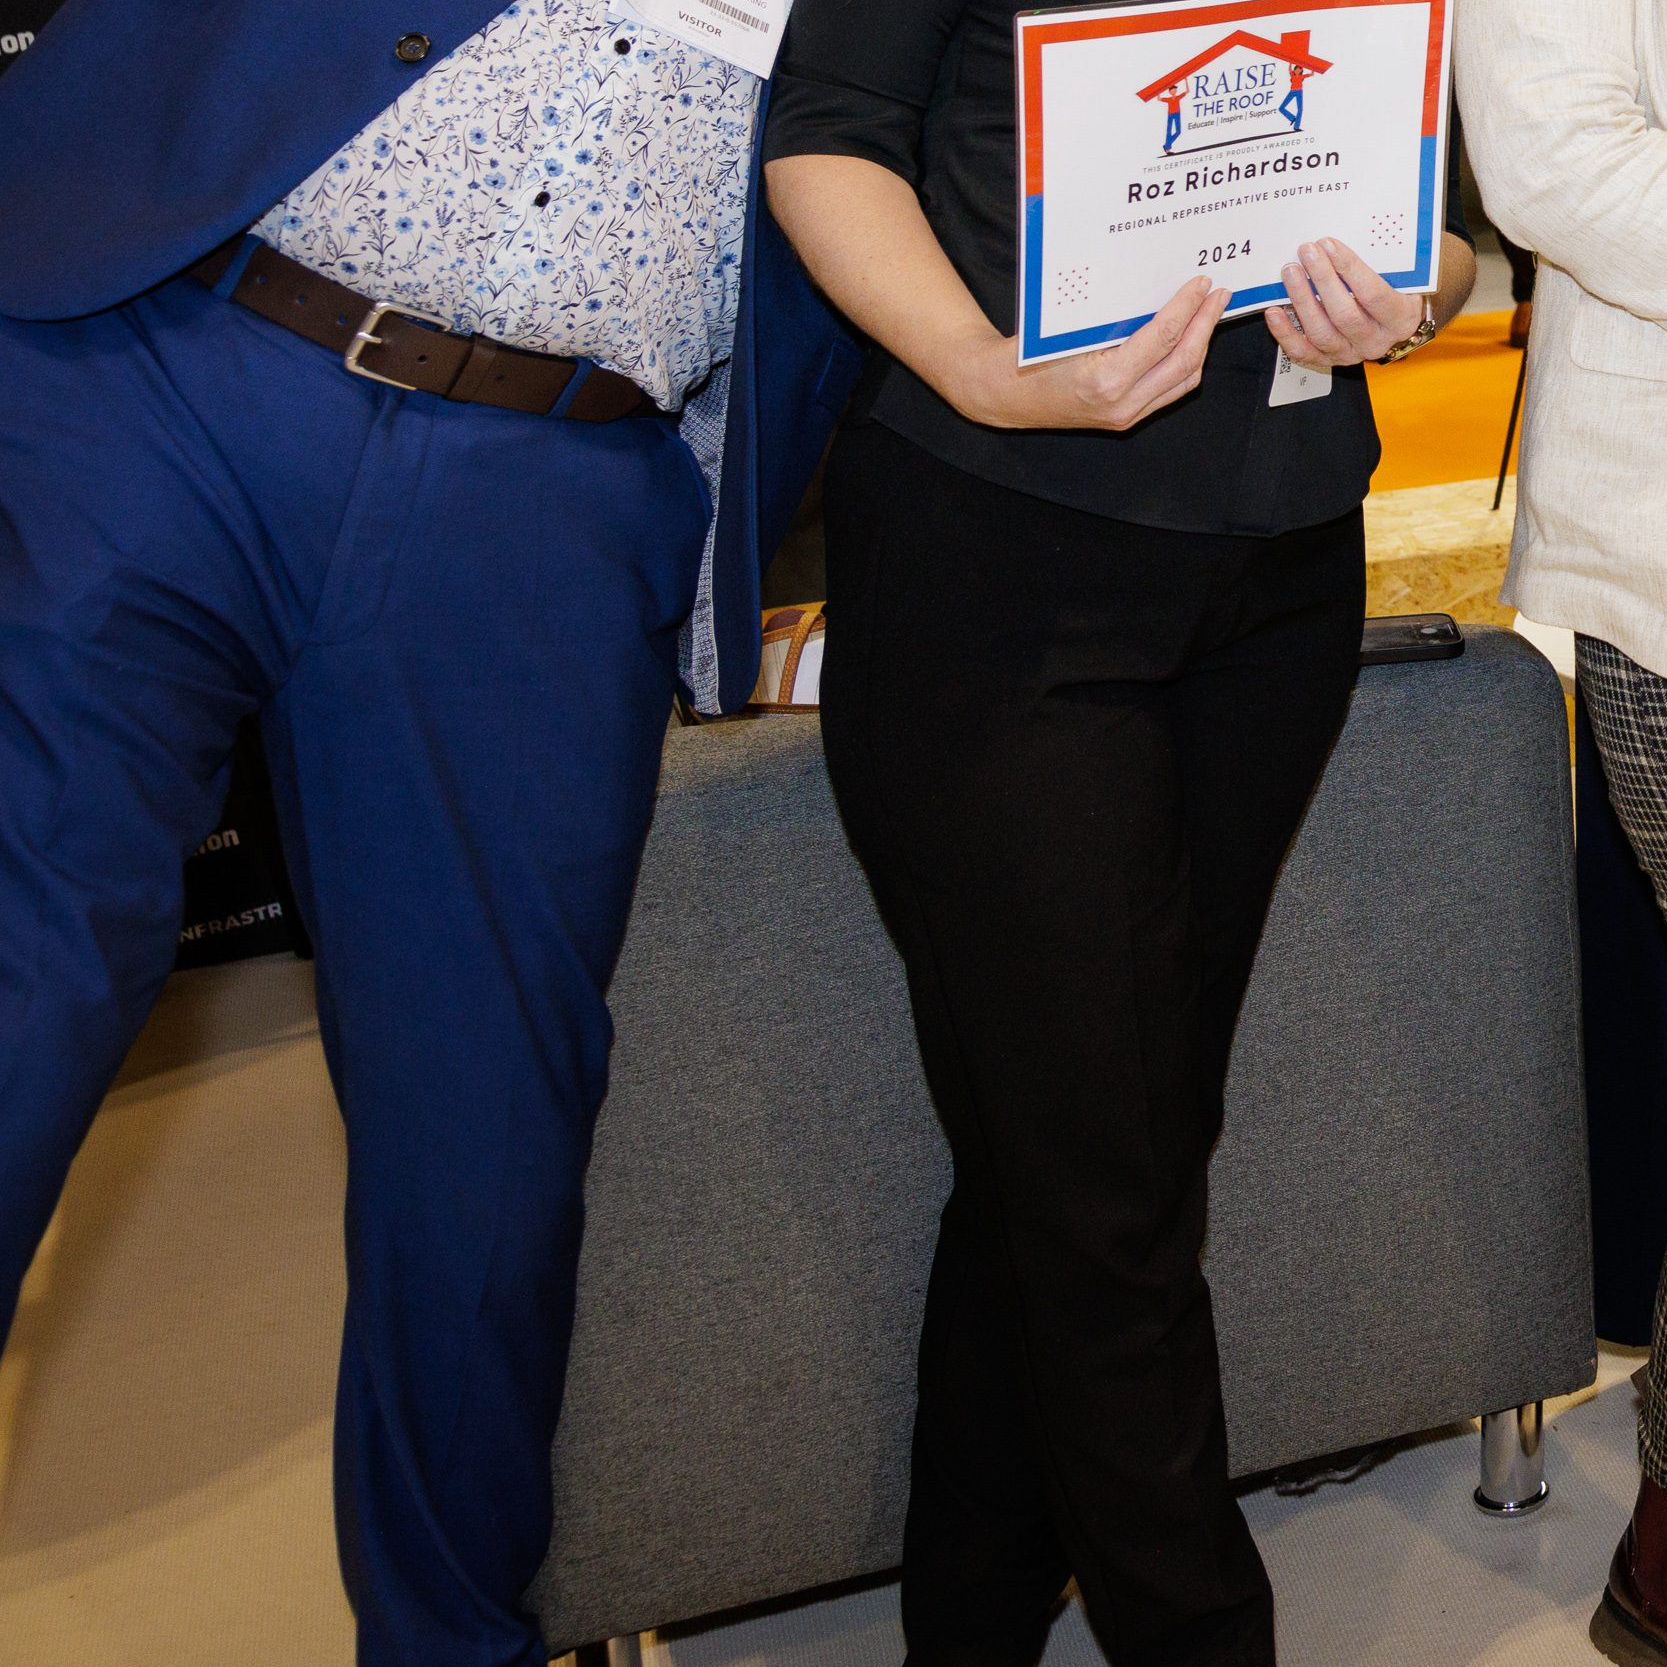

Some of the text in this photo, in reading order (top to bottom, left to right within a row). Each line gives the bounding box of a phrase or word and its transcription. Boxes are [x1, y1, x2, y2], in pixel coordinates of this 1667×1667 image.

[678, 10, 723, 38] VISITOR
[1192, 62, 1278, 100] RAISE
[1193, 91, 1274, 118] THE ROOF
[1127, 151, 1340, 203] Roz Richardson
[1109, 181, 1350, 234] REGIONAL REPRESENTATIVE SOUTH EAST
[1197, 239, 1252, 267] 2024
